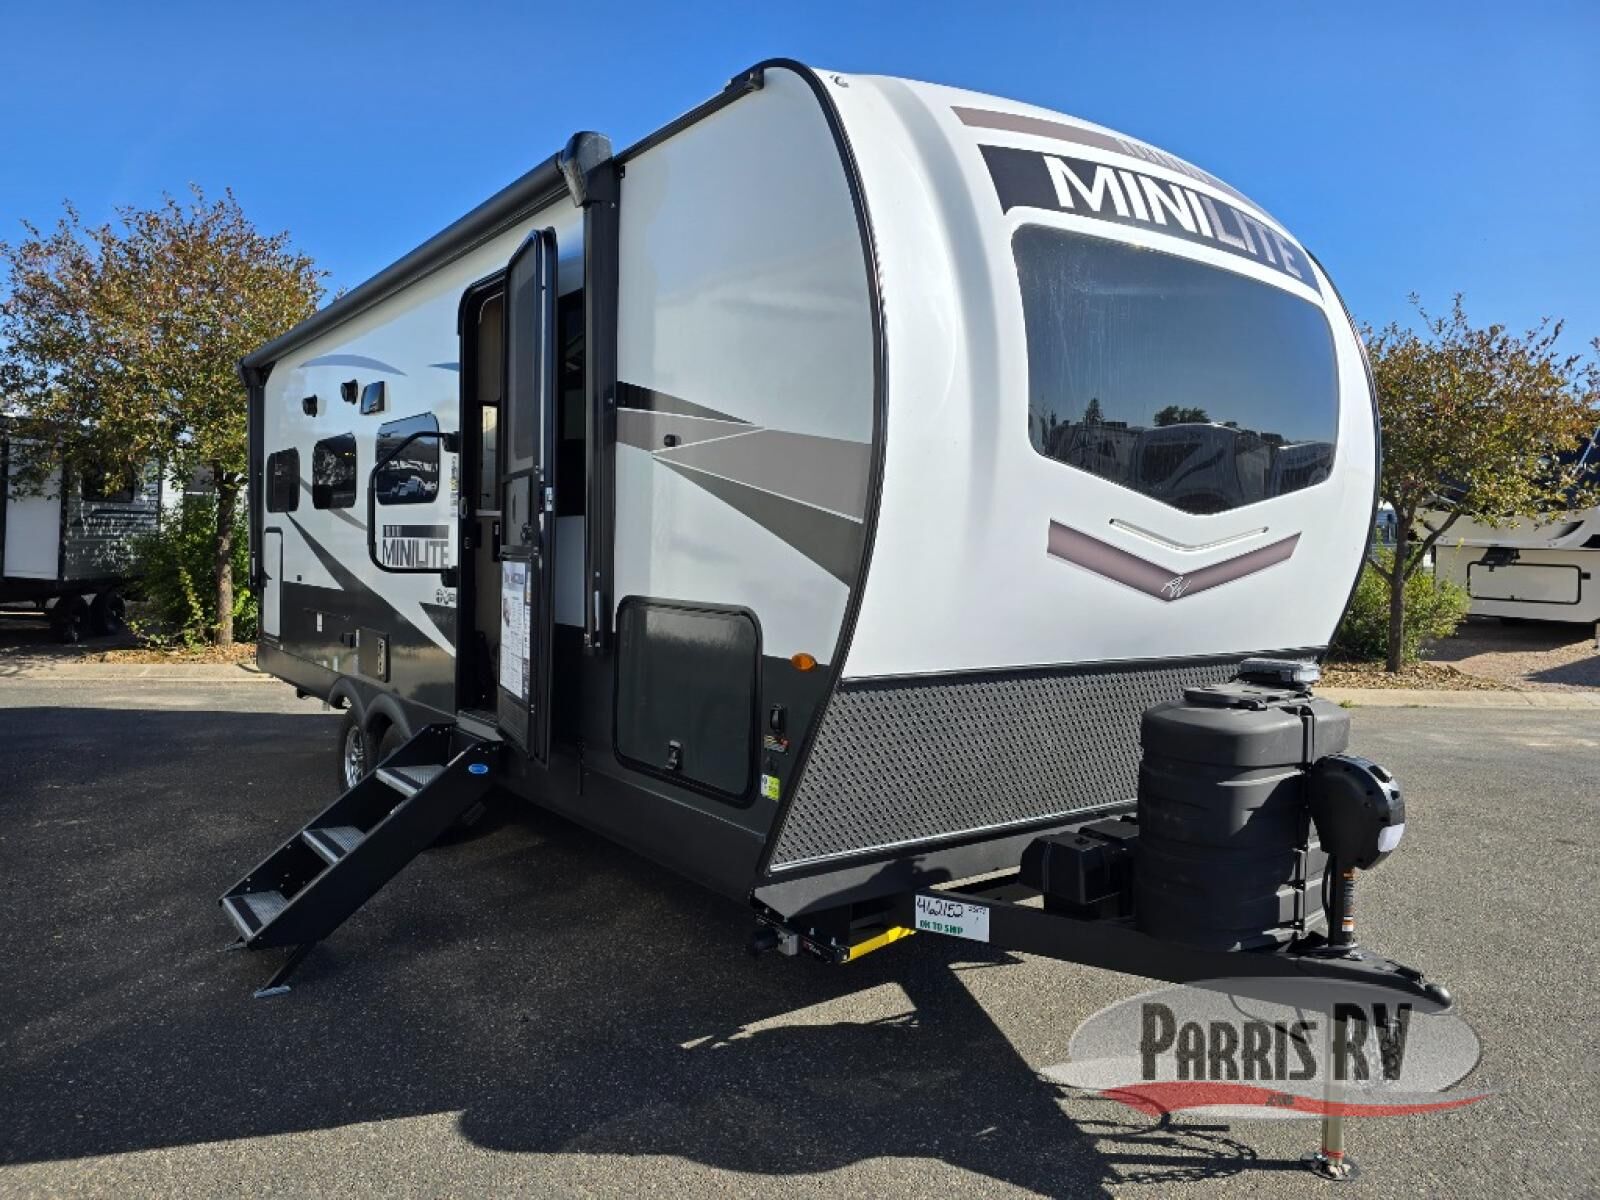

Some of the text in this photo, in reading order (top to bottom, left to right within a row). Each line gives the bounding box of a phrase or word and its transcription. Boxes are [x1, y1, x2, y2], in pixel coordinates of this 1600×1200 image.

[1043, 154, 1303, 279] MINILITE
[382, 538, 449, 568] MINILITE
[916, 897, 964, 918] 462152
[919, 919, 964, 935] OK TO SHIP
